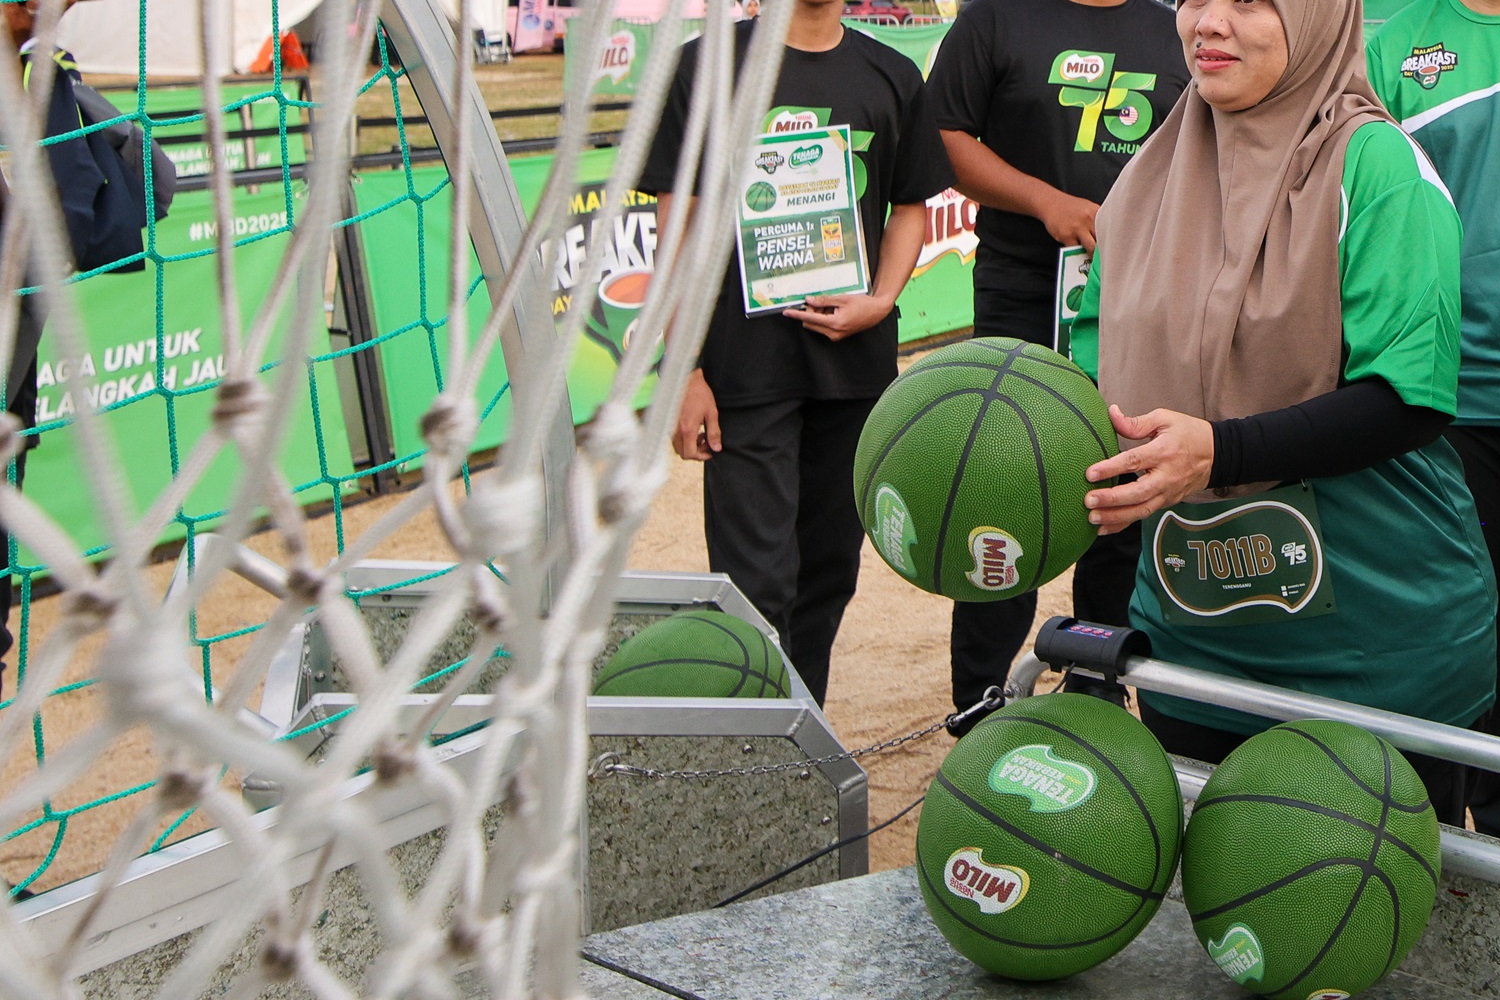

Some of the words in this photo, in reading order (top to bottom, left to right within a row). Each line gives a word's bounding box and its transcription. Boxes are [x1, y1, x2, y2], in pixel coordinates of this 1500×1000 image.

[598, 46, 629, 70] ILO
[1066, 62, 1100, 74] MILO
[1400, 50, 1456, 72] BREAKFAST
[1058, 71, 1157, 152] 75
[786, 192, 836, 207] MENANGI
[754, 221, 804, 238] PERCUMA
[806, 221, 815, 232] 1x
[756, 234, 815, 256] PENSEL
[758, 249, 815, 271] WARNA
[103, 327, 202, 373] UNTUK
[183, 353, 229, 387] JAU
[982, 537, 1007, 587] MILO
[1187, 533, 1276, 580] 7011B
[1284, 544, 1307, 566] 75
[998, 762, 1074, 806] TENAGA
[951, 859, 1017, 904] MILO
